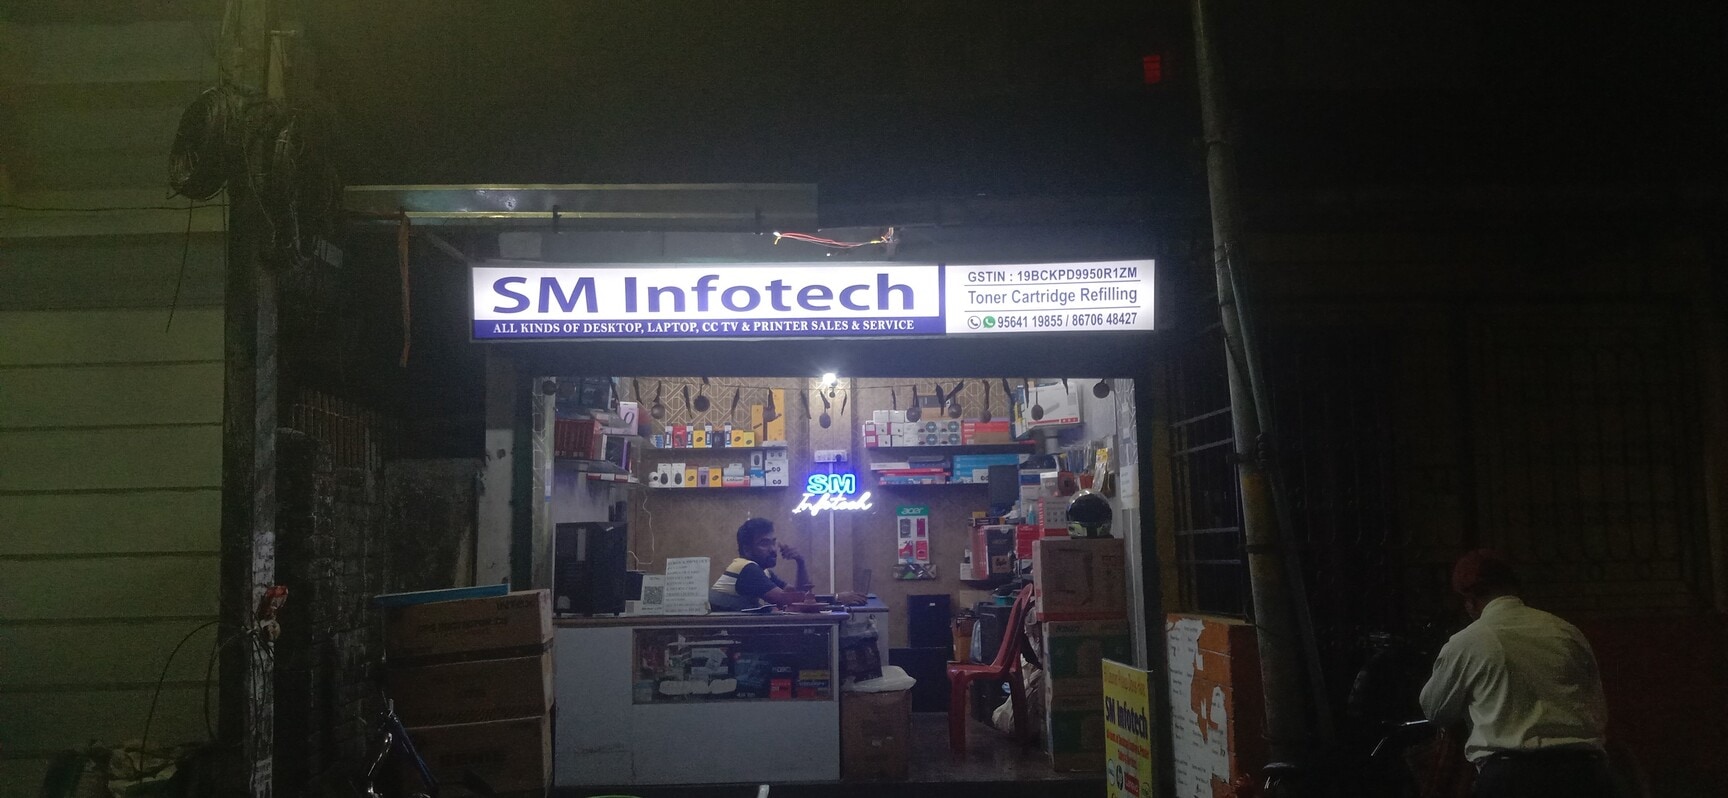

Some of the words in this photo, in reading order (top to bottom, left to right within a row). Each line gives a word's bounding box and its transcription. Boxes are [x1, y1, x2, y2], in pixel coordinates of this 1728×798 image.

[968, 271, 1006, 283] GSTIN
[1017, 267, 1137, 282] 19BCKPD9950R1ZM
[492, 276, 599, 314] SM
[624, 273, 915, 313] Infotech
[968, 290, 1007, 305] Toner
[1011, 289, 1076, 306] Cartridge
[1080, 287, 1137, 303] Refilling
[493, 323, 518, 334] ALL
[520, 323, 561, 334] KINDS
[563, 322, 581, 334] OF
[583, 322, 644, 334] DESKTOP,
[647, 322, 699, 333] LAPTOP,
[701, 321, 719, 333] CC
[721, 321, 739, 333] TV
[741, 321, 751, 333] &
[753, 321, 809, 332] PRINTER
[811, 320, 849, 332] SALES
[851, 320, 861, 332] &
[862, 320, 915, 332] SERVICE
[997, 316, 1028, 328] 95641
[1032, 315, 1063, 328] 19855
[1072, 314, 1103, 327] 86706
[1106, 312, 1137, 325] 48427
[807, 474, 856, 494] SM
[792, 492, 872, 516] Infotech
[901, 507, 925, 515] acer
[1105, 695, 1116, 725] SM
[1117, 700, 1148, 740] Infotech
